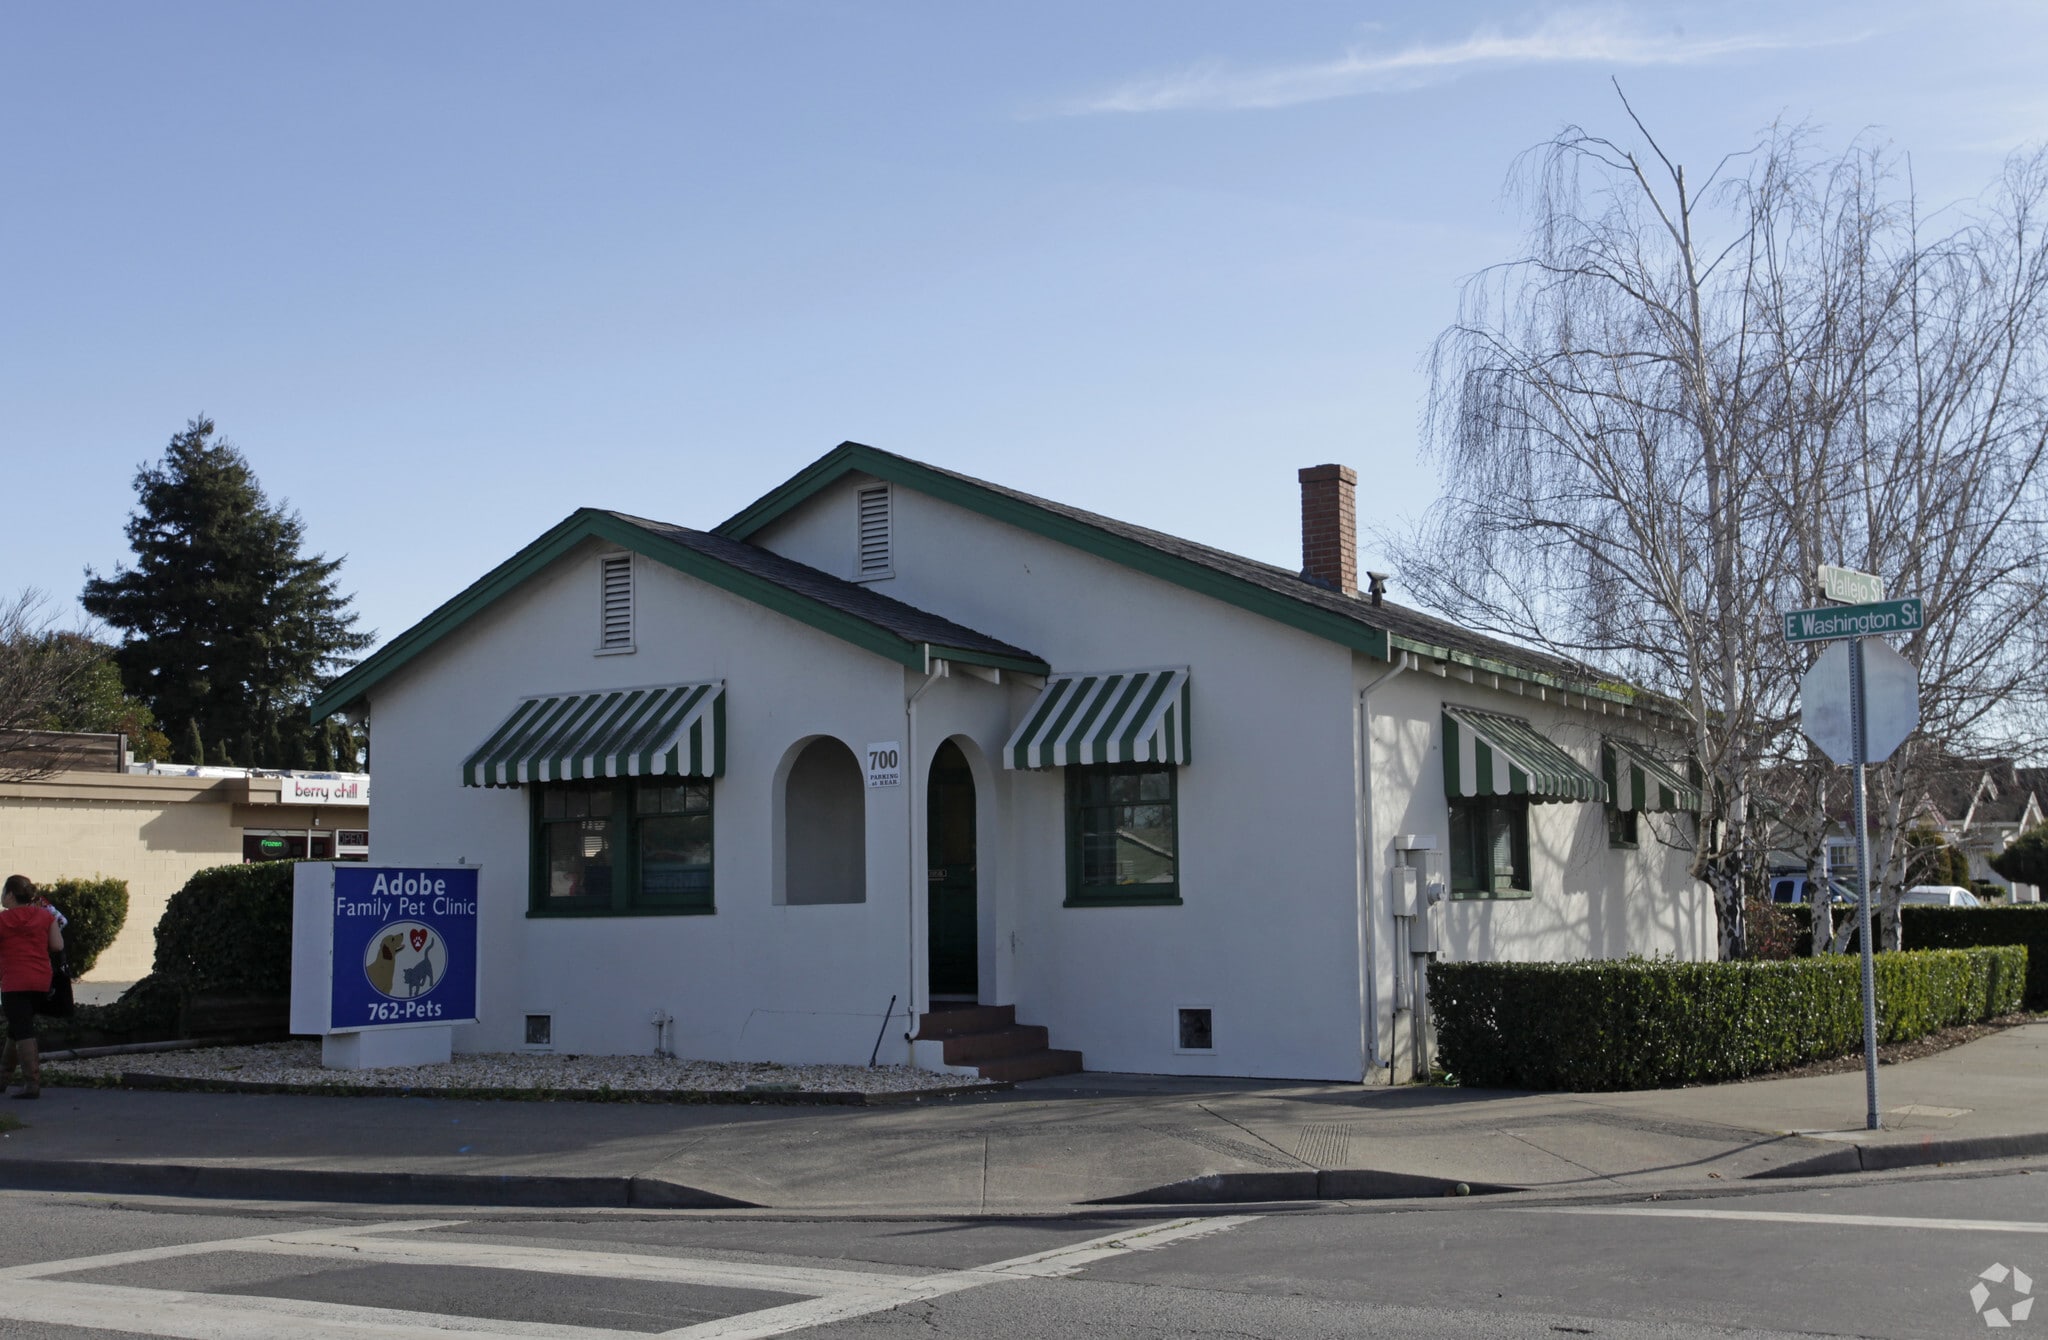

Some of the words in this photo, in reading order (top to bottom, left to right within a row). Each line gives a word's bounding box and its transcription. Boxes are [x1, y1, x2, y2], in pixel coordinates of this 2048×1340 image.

[1829, 569, 1868, 601] Vallejo
[1870, 579, 1880, 601] St
[1787, 615, 1797, 637] E
[1801, 612, 1897, 636] Washington
[1901, 602, 1918, 626] St
[869, 749, 898, 771] 700
[295, 781, 328, 802] berry
[334, 783, 358, 799] chill
[261, 839, 282, 847] Frozen
[371, 872, 446, 896] Adobe
[336, 897, 392, 921] Family
[399, 897, 425, 916] Pet
[432, 897, 476, 916] Clinic
[368, 1000, 442, 1021] 762-Pets
